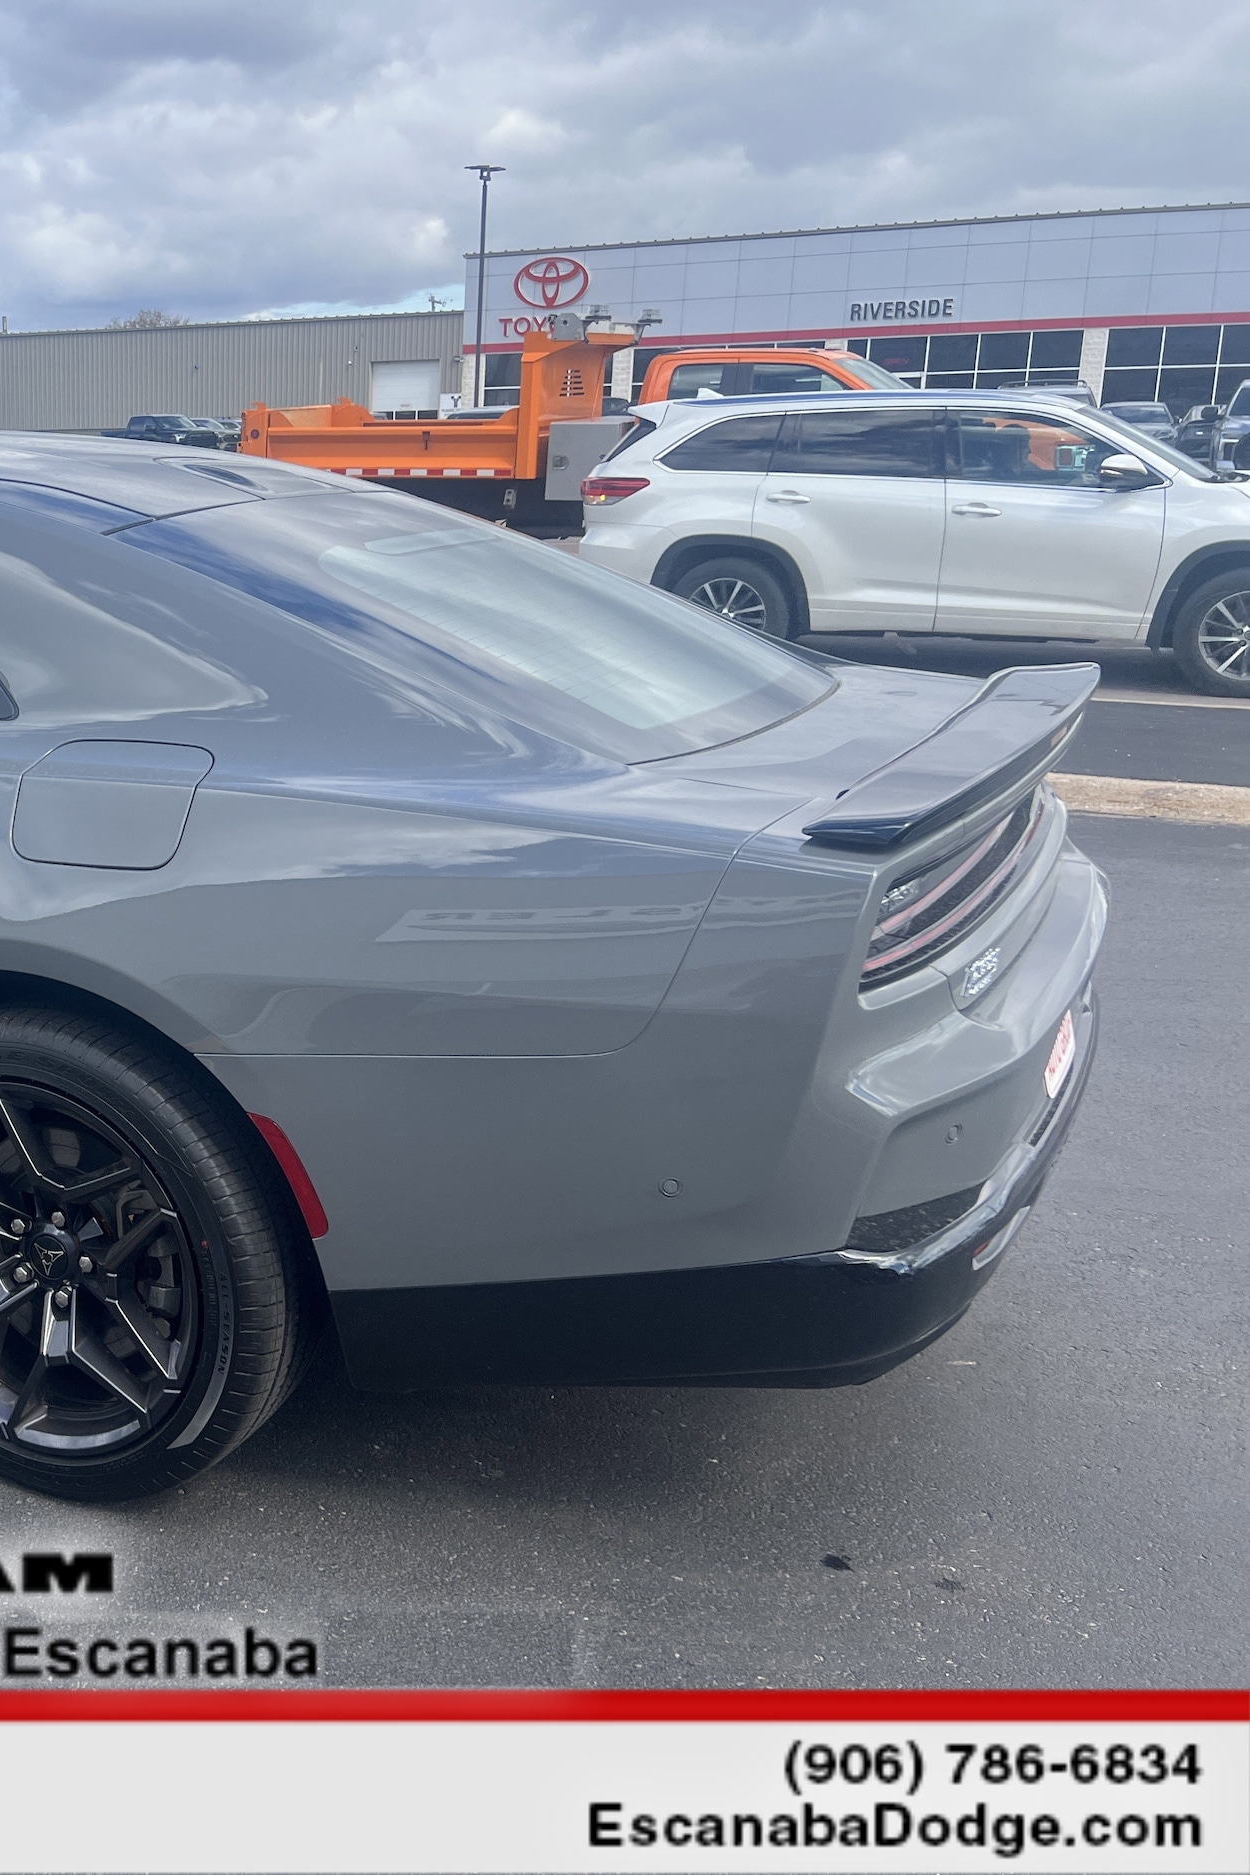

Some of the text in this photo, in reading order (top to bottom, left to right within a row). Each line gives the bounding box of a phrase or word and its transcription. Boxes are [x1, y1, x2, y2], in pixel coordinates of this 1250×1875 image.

[850, 298, 954, 321] RIVERSIDE
[498, 315, 555, 337] TOY
[217, 1270, 232, 1376] ALL-SEASON
